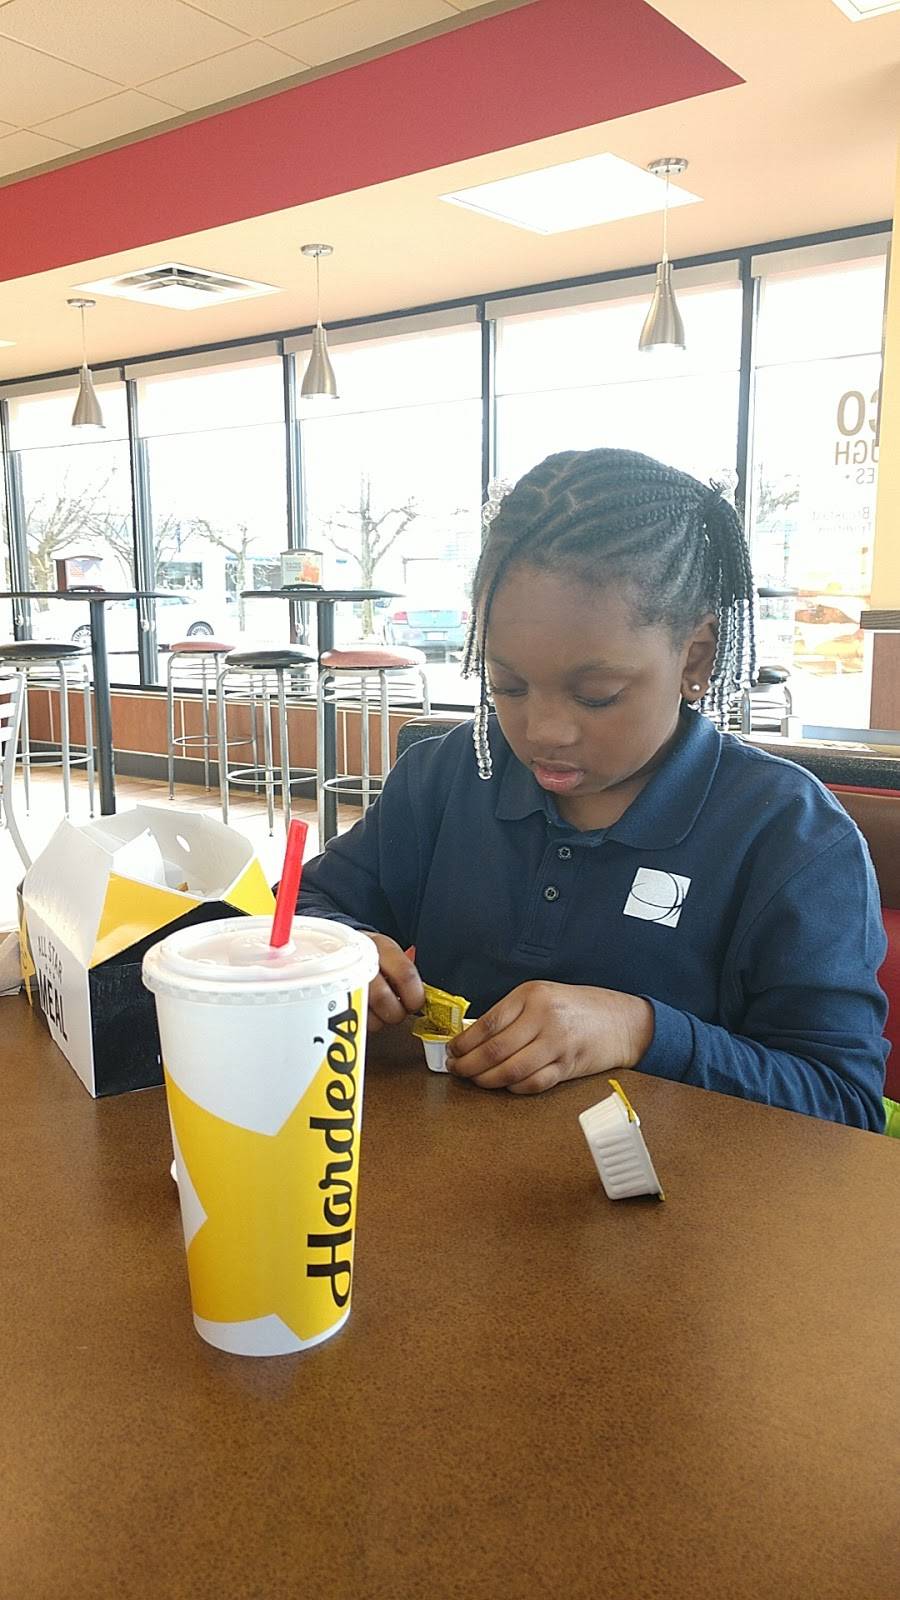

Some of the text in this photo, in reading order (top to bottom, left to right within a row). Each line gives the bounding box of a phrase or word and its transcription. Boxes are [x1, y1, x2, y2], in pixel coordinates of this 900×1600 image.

[48, 941, 63, 984] STAR
[39, 968, 68, 1042] MEAL
[306, 992, 359, 1308] Hardee's
